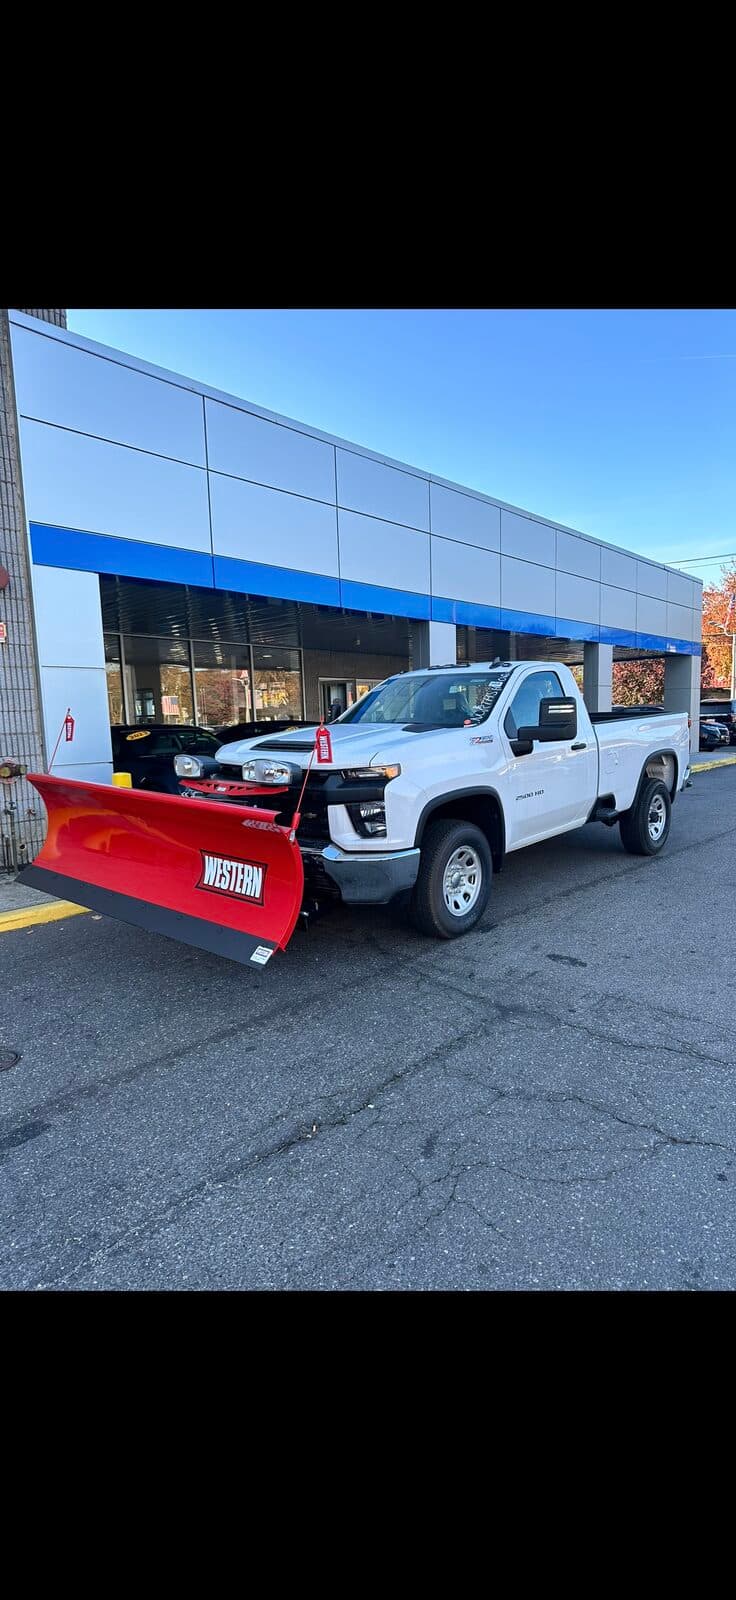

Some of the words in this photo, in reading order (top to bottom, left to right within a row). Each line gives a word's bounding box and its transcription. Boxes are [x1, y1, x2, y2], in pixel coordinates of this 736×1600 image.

[320, 735, 329, 759] WESTERN
[515, 792, 534, 801] 2500
[203, 855, 263, 898] WESTERN
